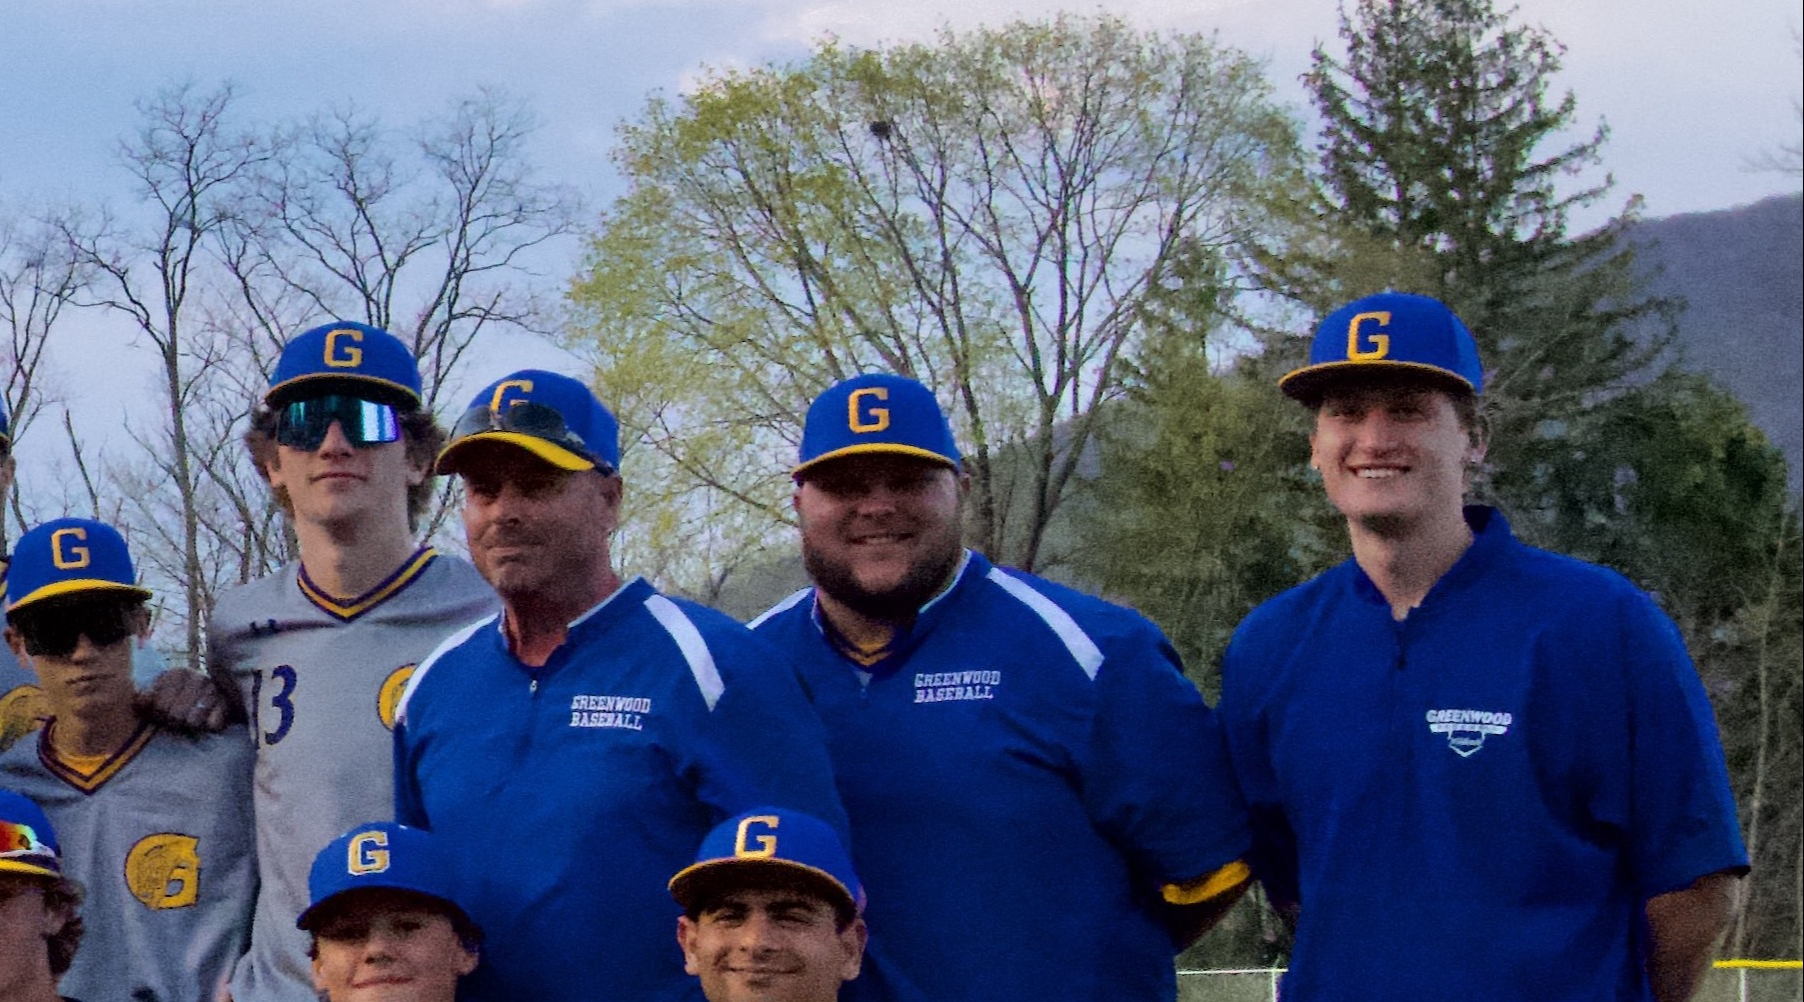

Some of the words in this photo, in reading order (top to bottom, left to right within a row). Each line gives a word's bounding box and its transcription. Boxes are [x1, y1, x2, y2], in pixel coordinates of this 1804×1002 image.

[323, 329, 363, 368] G
[1346, 311, 1391, 361] G
[848, 387, 890, 433] G
[52, 528, 91, 569] G
[914, 670, 1001, 688] GREENWOOD
[914, 685, 994, 703] BASEBALL
[569, 712, 643, 731] BASEBALL
[570, 695, 651, 714] GREENWOOD
[1425, 709, 1512, 725] GREENWOOD
[346, 830, 391, 876] G
[734, 815, 779, 858] G
